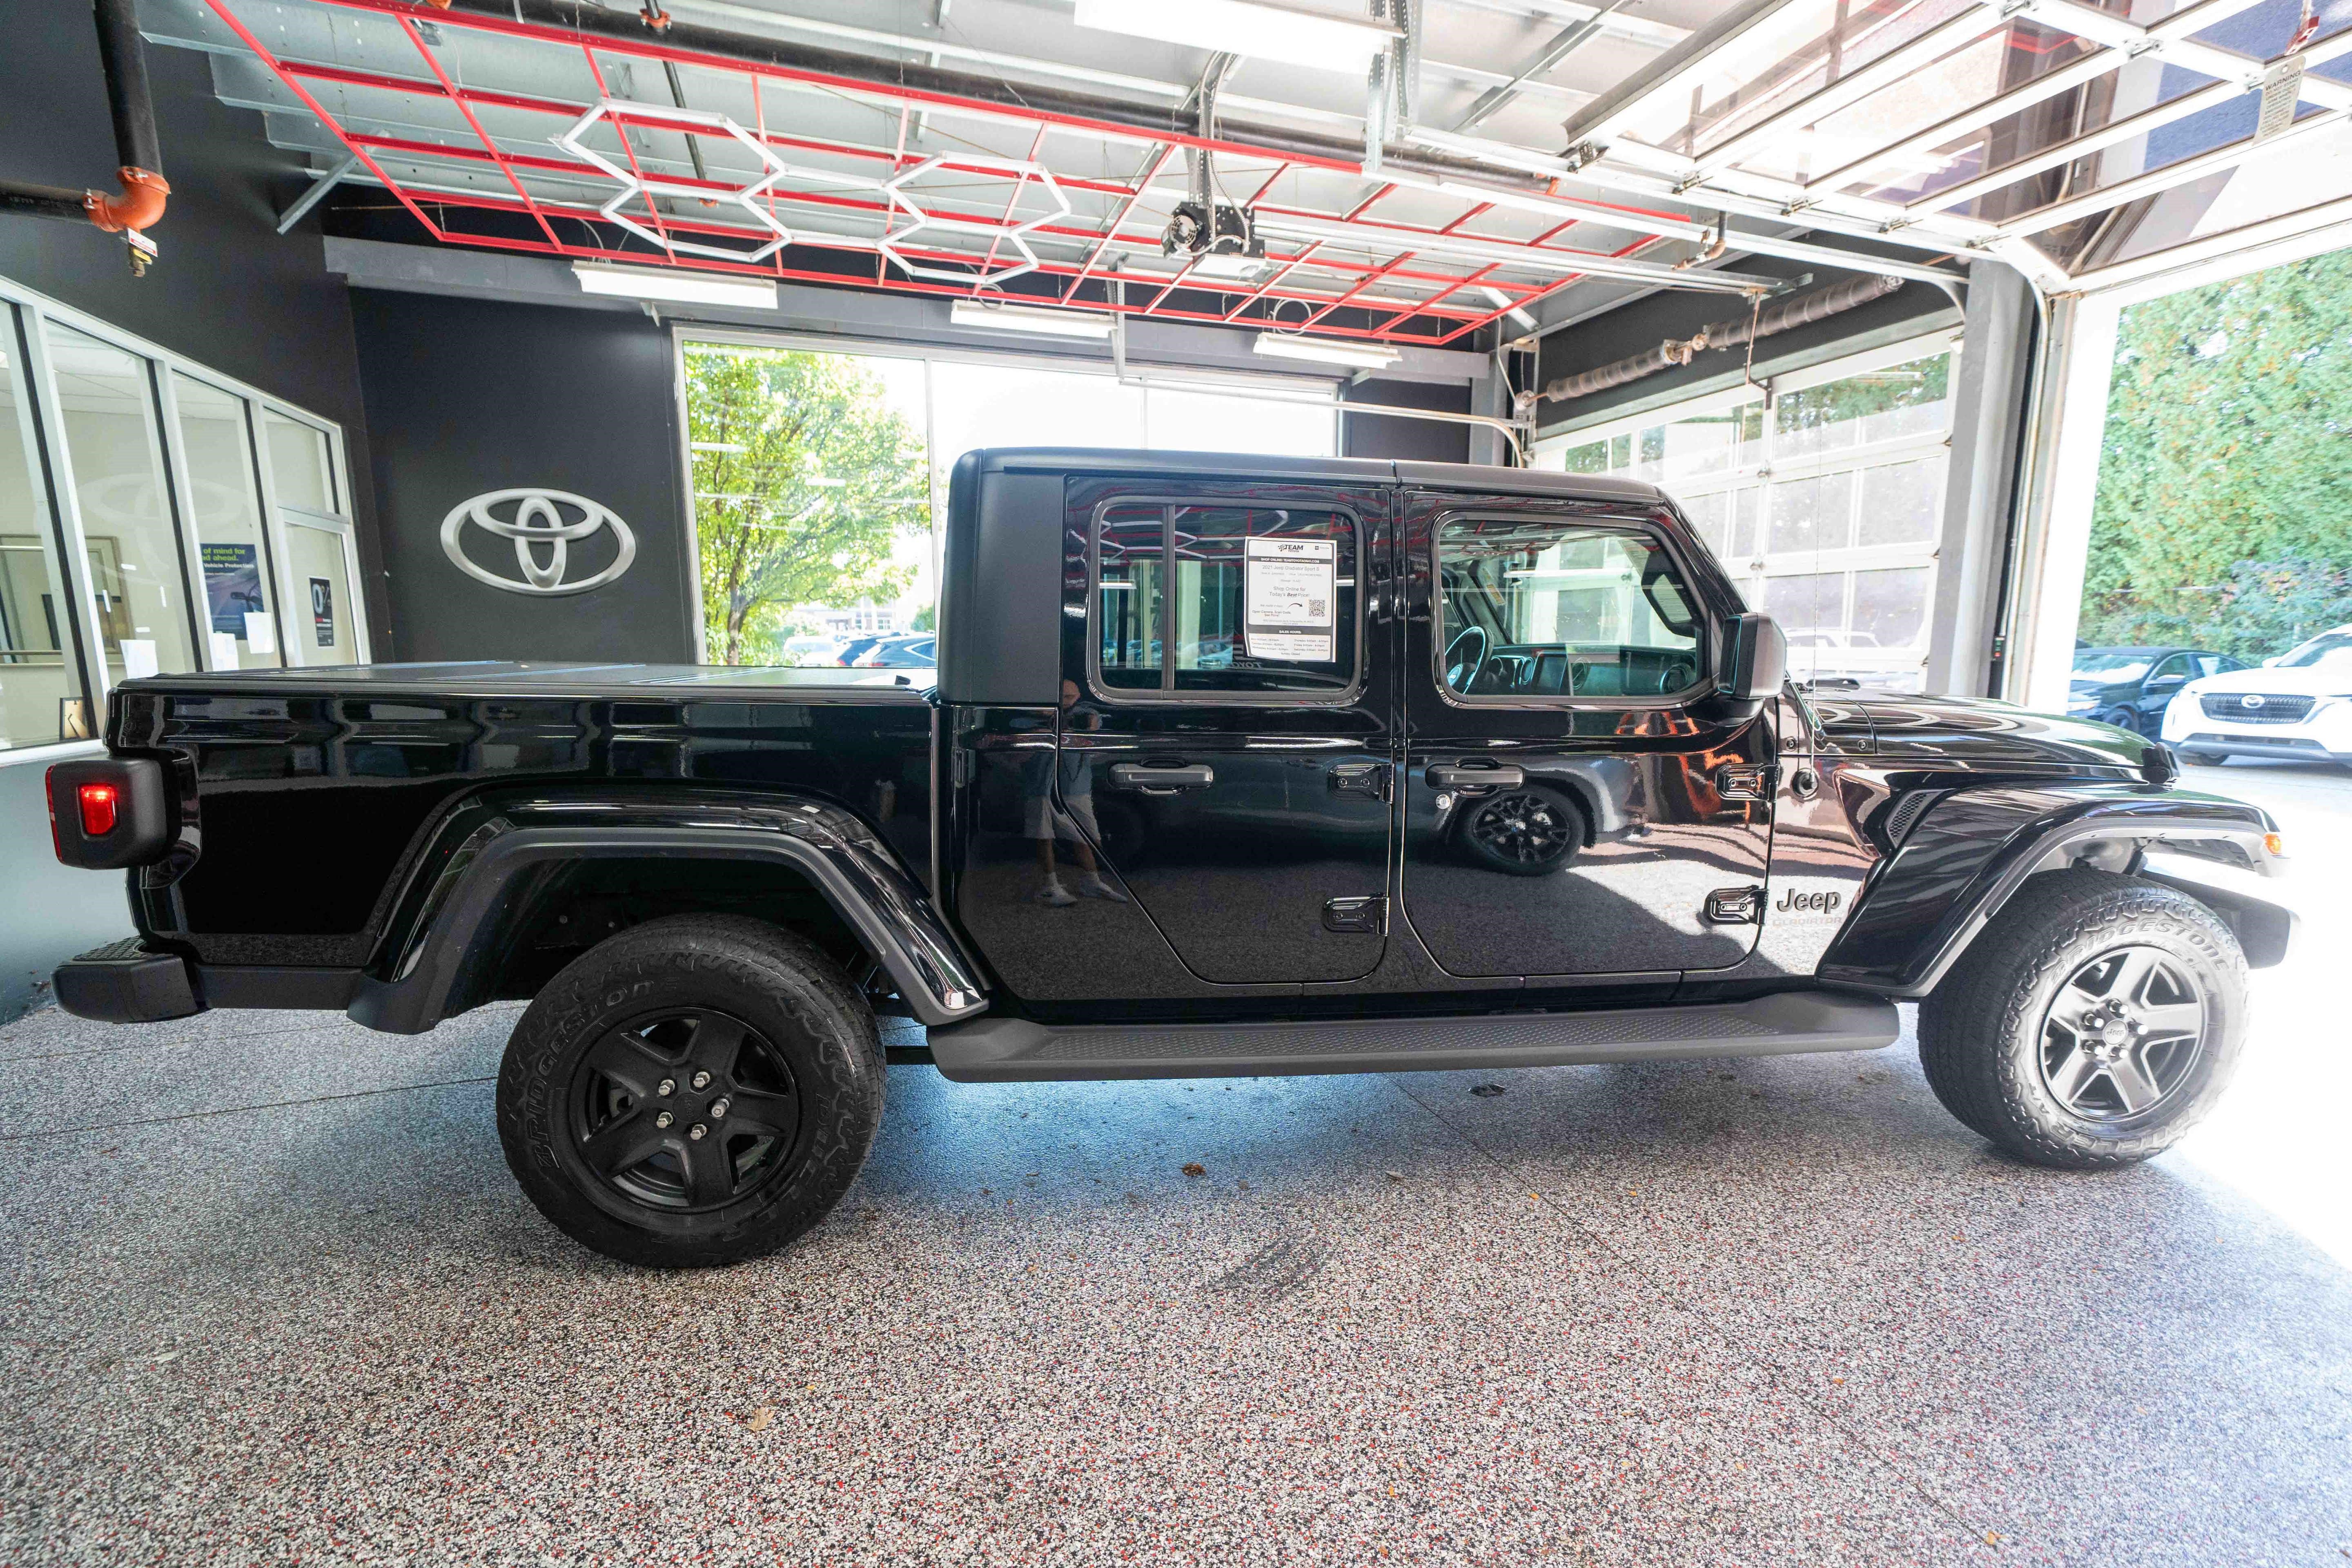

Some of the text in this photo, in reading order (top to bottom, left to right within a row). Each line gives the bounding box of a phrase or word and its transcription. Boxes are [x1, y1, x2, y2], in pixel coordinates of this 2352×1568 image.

[2266, 70, 2301, 90] WARNING
[312, 584, 332, 614] 0%
[1777, 889, 1841, 914] Jeep
[2051, 918, 2230, 981] BRIDGESTONE
